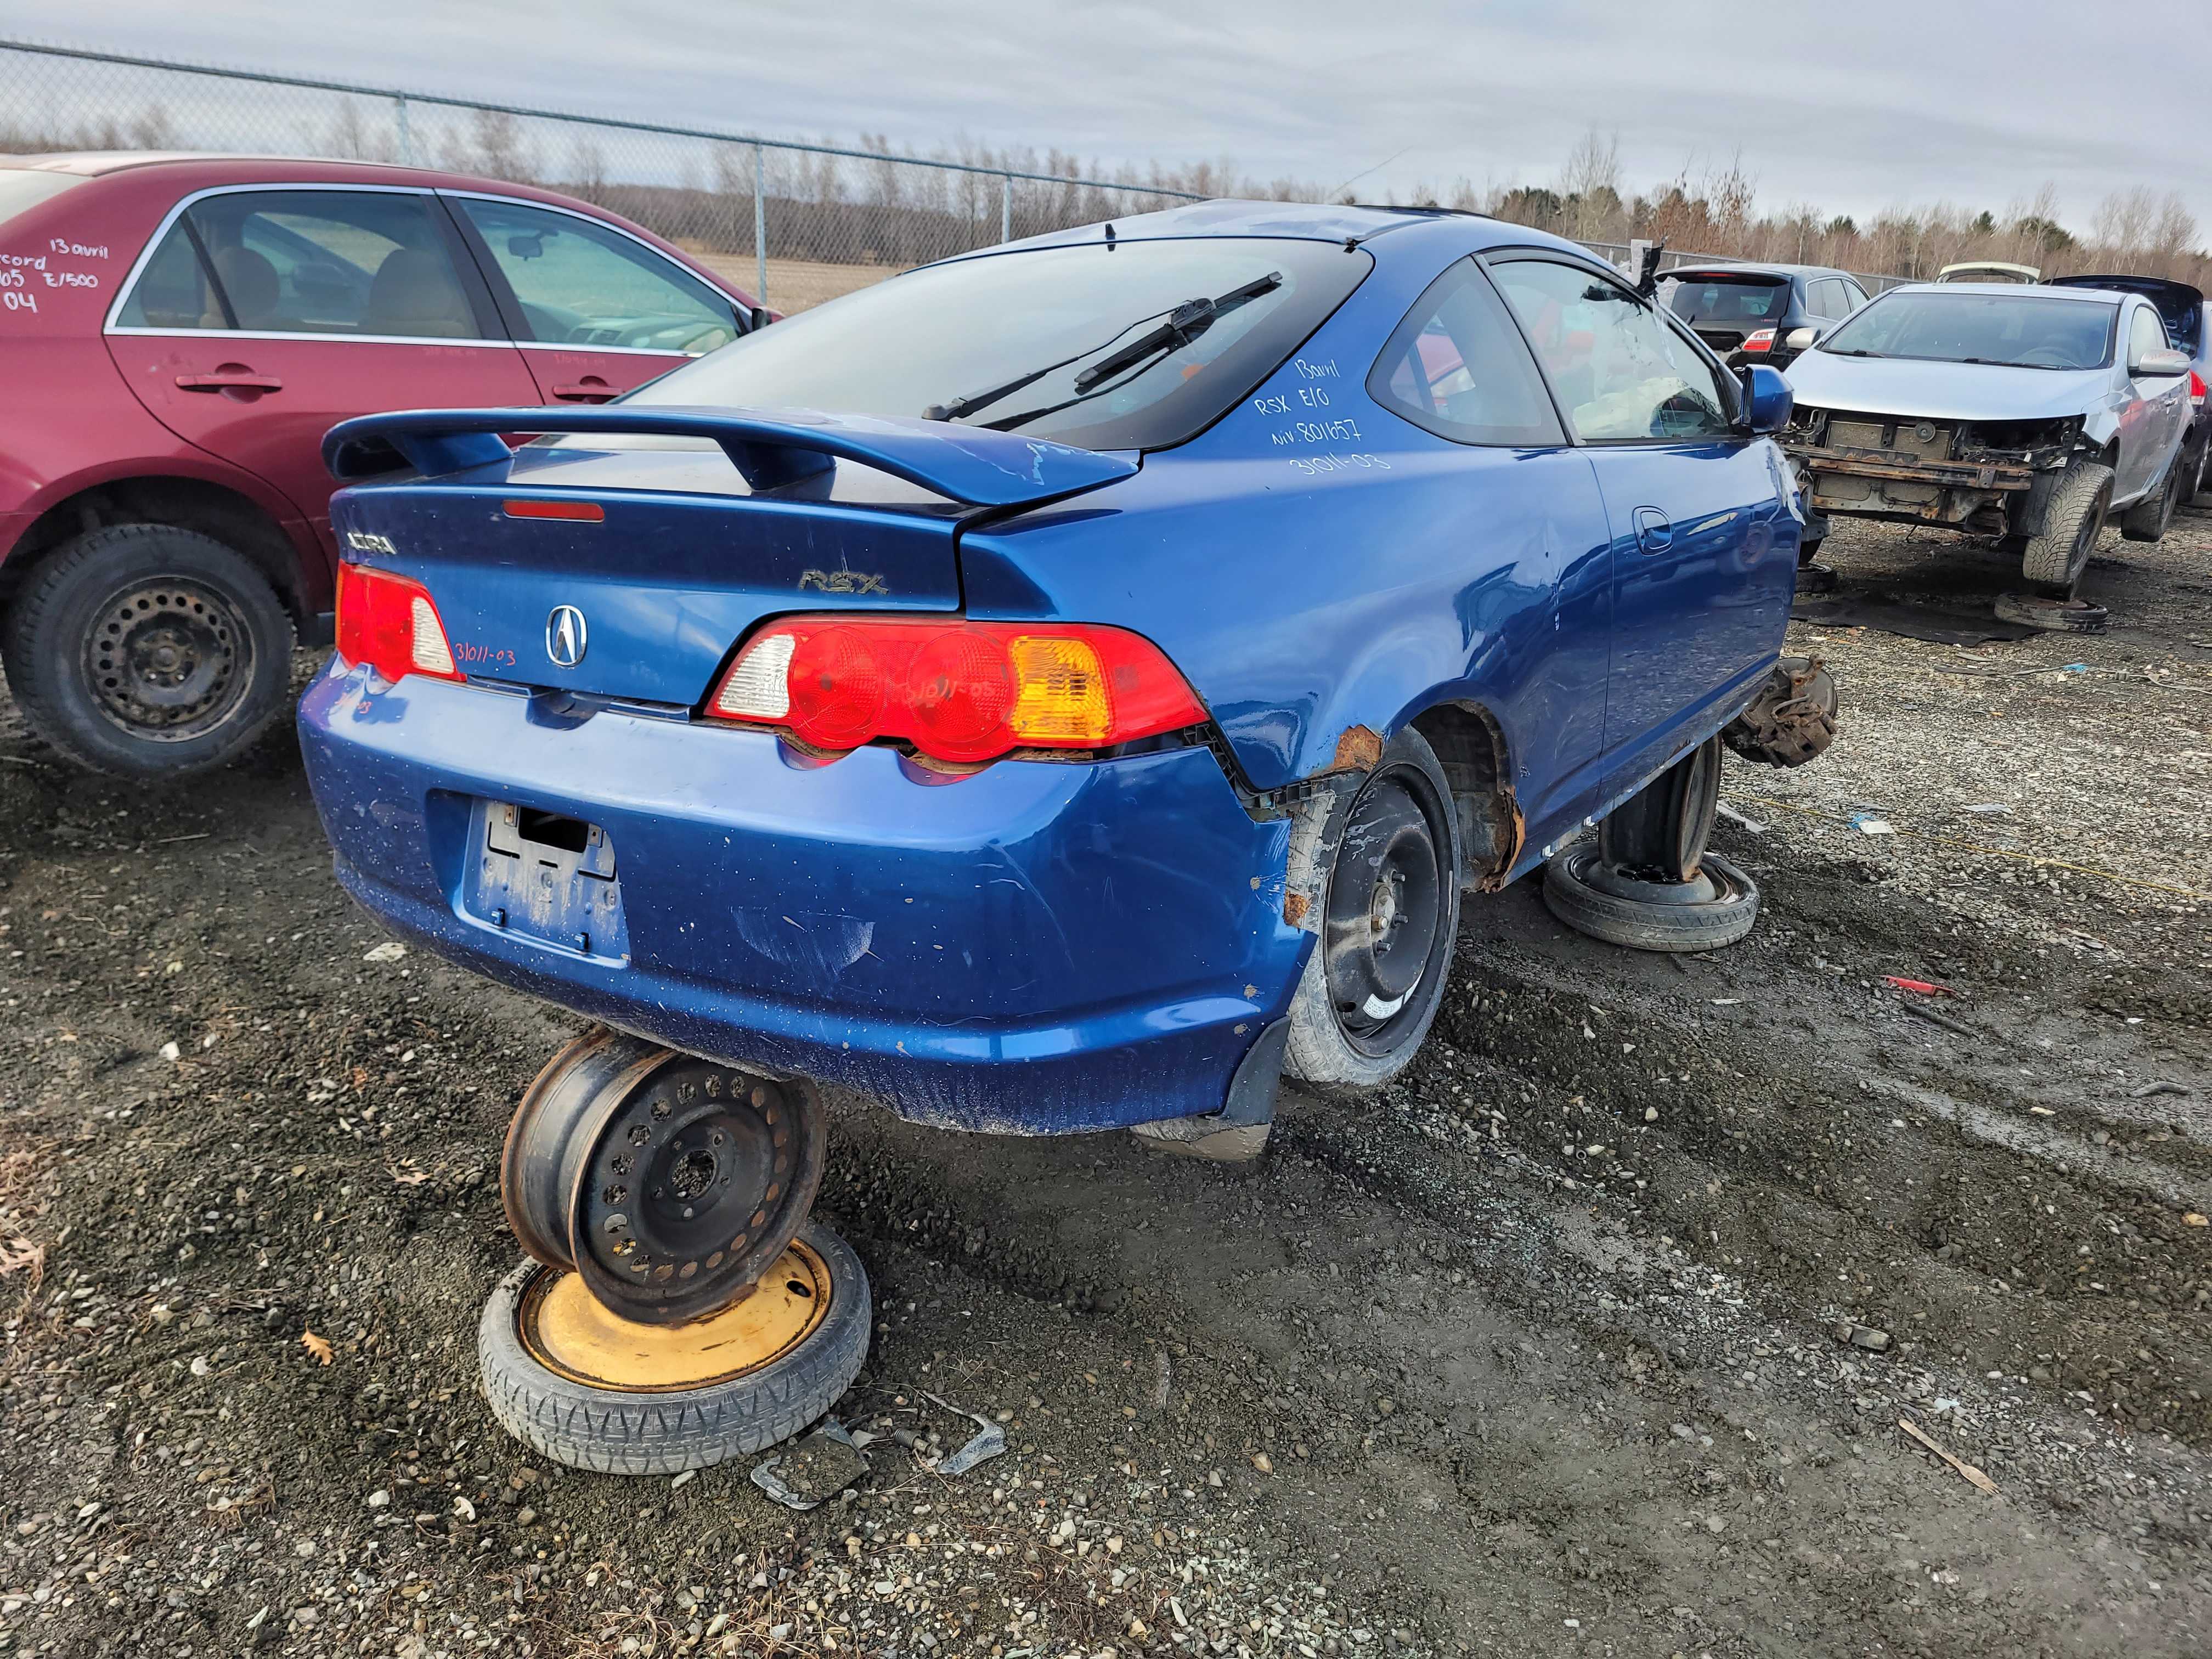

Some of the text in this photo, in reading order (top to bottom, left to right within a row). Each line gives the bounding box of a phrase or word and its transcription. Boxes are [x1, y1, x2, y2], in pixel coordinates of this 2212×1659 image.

[49, 238, 109, 259] 13 avril
[0, 254, 47, 271] cord
[3, 291, 38, 314] 04
[1254, 394, 1292, 416] RSX
[1290, 452, 1392, 476] 31011-03
[798, 568, 890, 595] RSX
[455, 641, 516, 667] 31011-03
